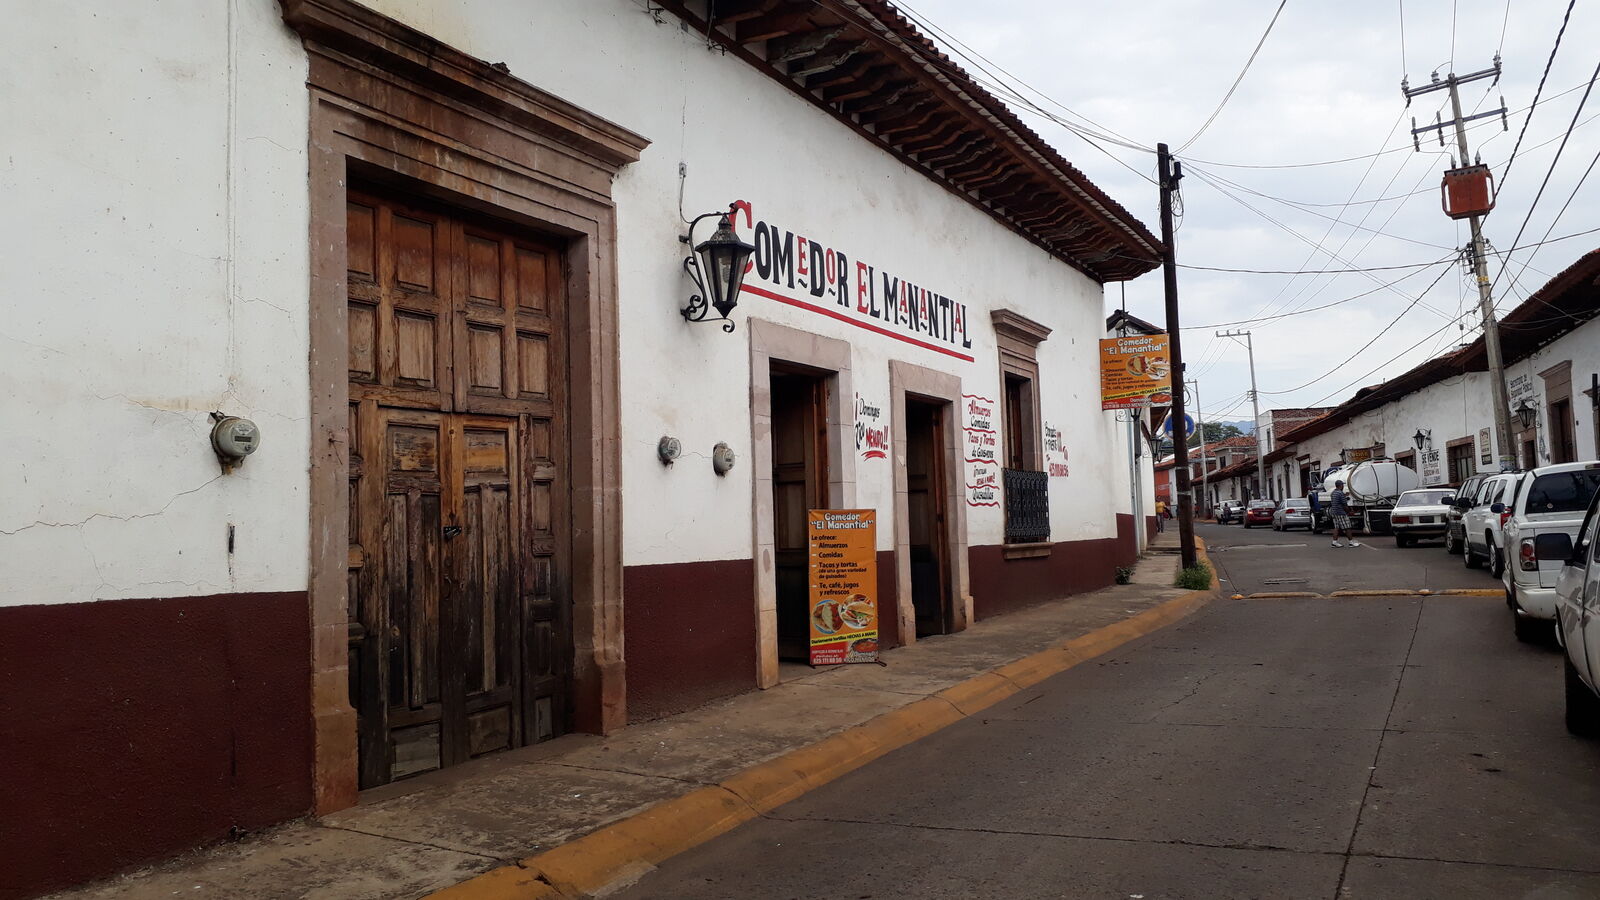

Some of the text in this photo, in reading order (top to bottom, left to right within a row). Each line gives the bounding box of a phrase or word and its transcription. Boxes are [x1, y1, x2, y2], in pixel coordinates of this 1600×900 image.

[856, 260, 880, 319] EL
[882, 272, 972, 349] MANANTIAL
[1117, 337, 1153, 346] Comedor
[824, 512, 860, 521] Comedor
